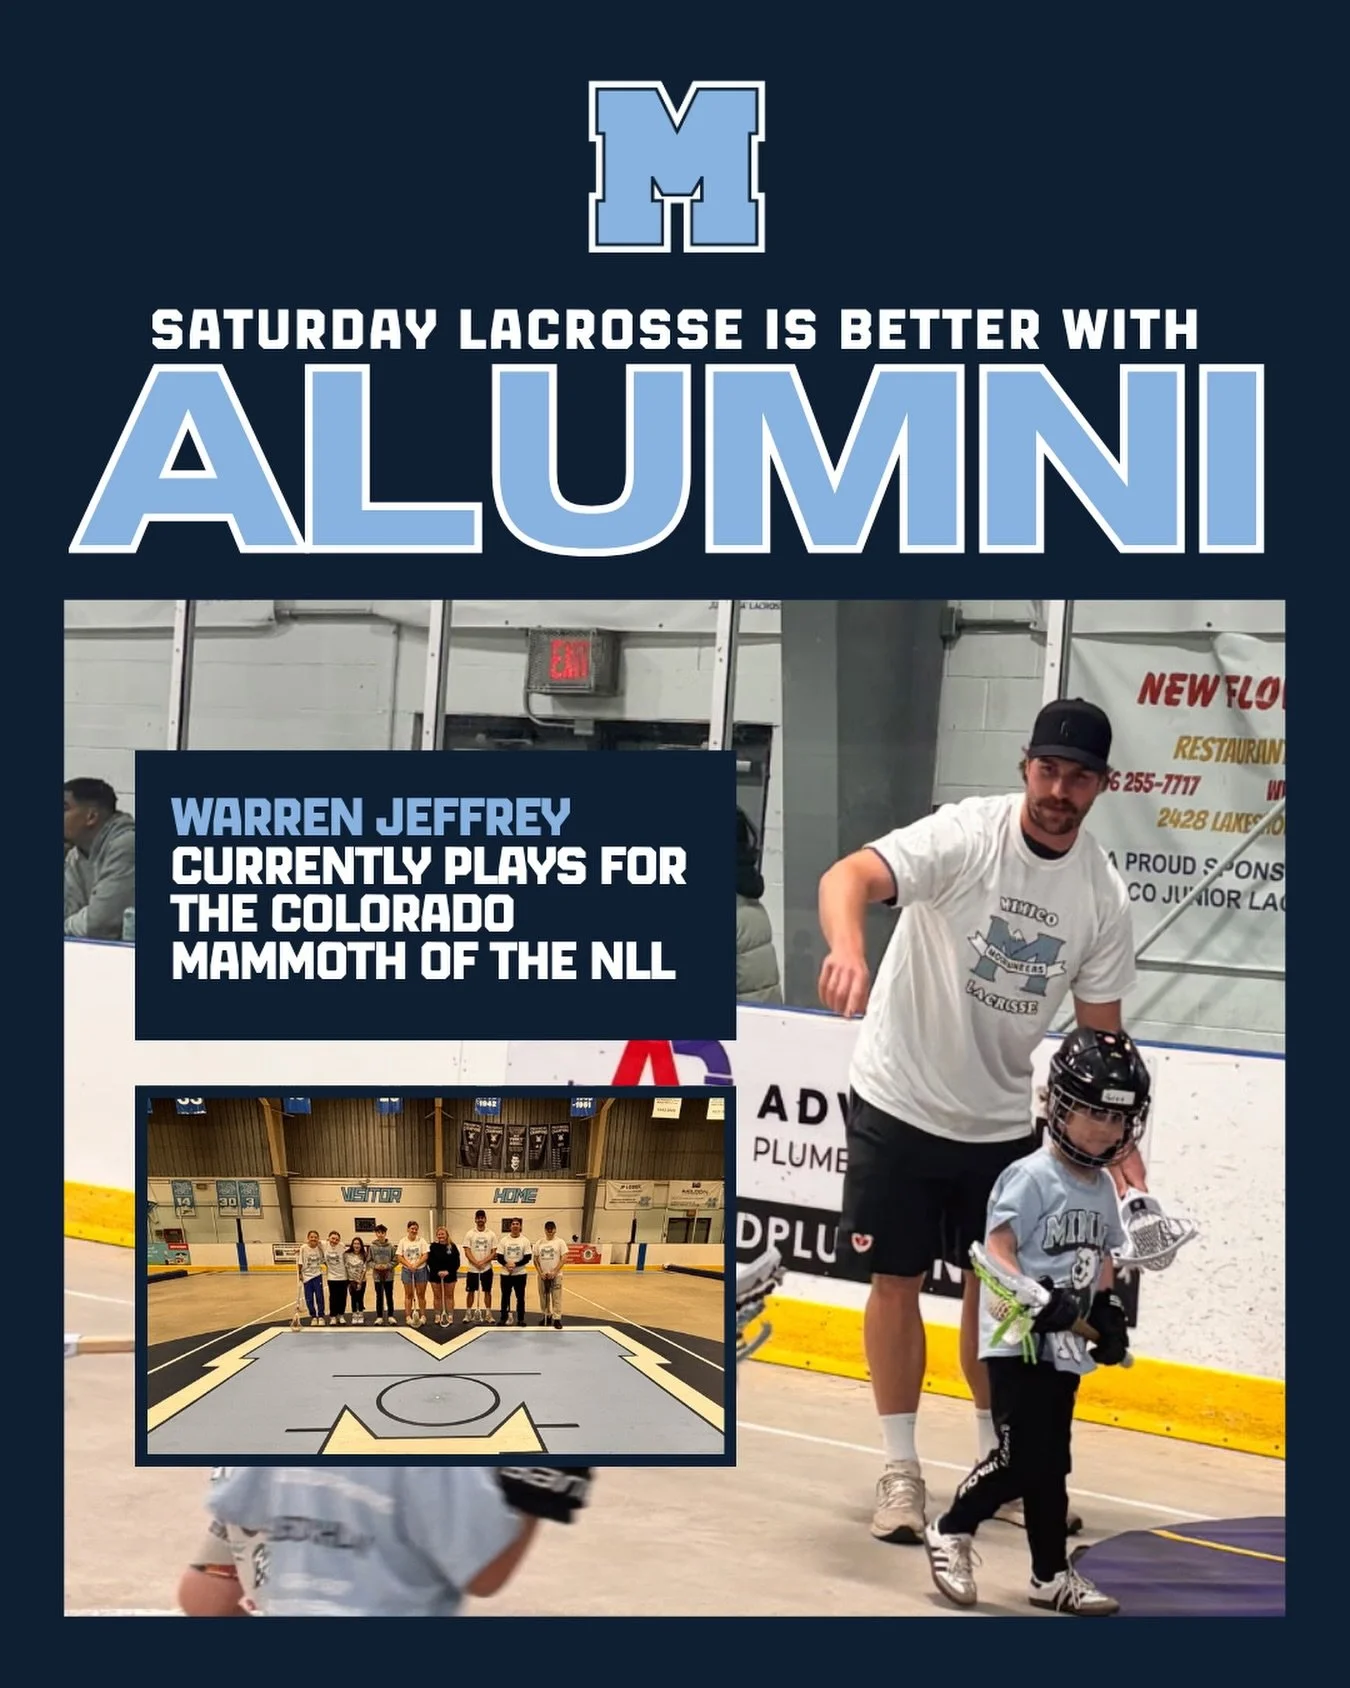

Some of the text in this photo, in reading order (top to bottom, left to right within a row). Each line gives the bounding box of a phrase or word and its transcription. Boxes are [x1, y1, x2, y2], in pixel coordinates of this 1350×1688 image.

[1137, 672, 1220, 707] NEW
[1123, 772, 1202, 795] 255-7717
[1157, 807, 1208, 831] 2428
[1125, 852, 1197, 876] PROUD
[219, 1197, 237, 1206] 30
[341, 1186, 403, 1204] VISITOR
[493, 1187, 539, 1204] HOME
